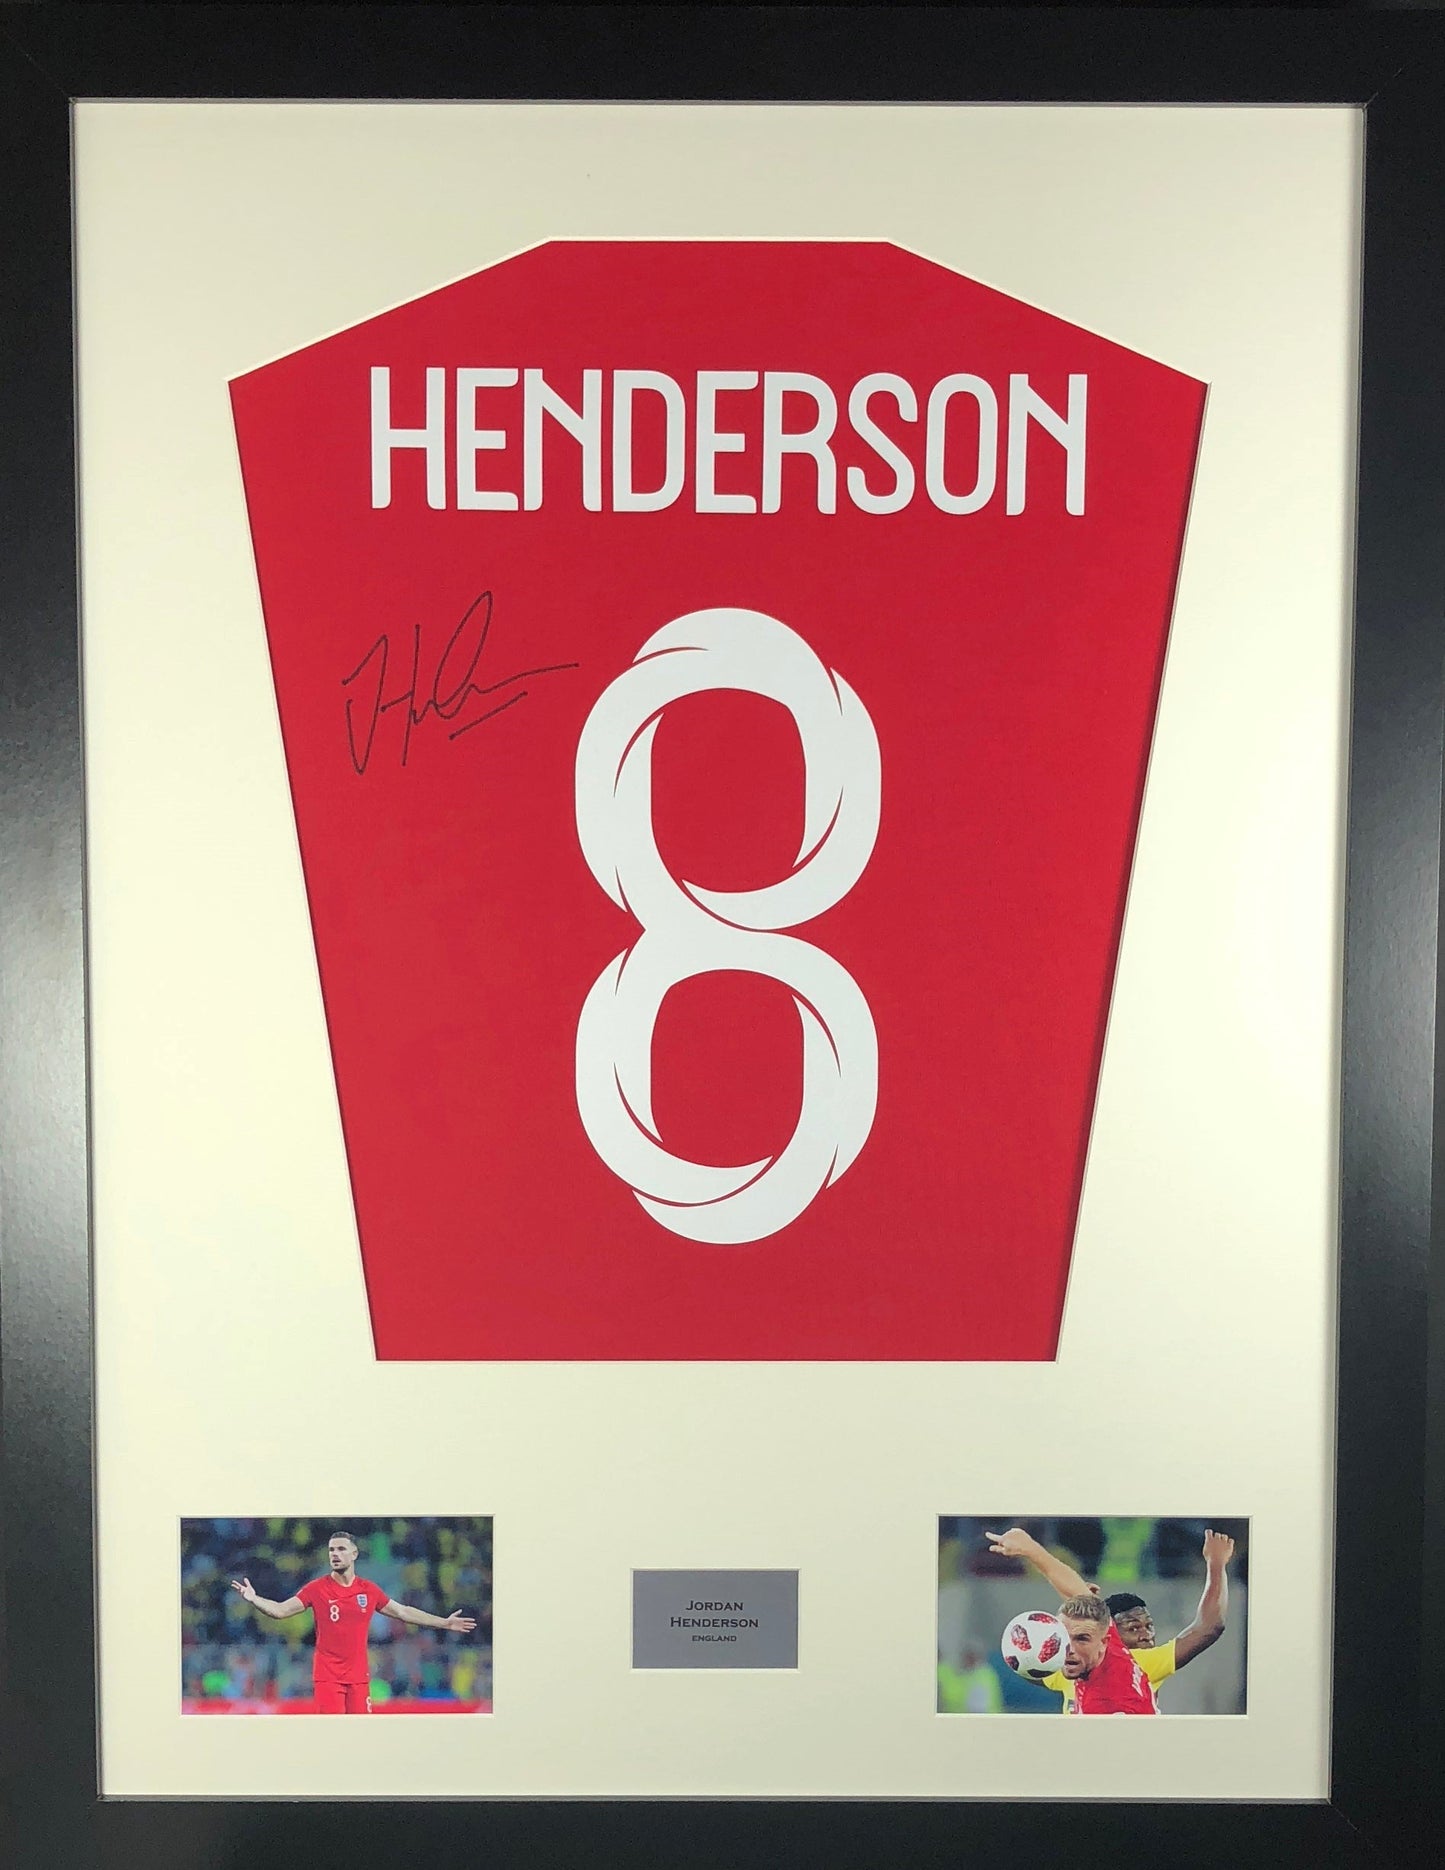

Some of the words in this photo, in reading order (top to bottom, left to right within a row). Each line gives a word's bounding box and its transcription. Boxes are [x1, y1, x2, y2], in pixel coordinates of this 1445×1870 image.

[371, 367, 1088, 516] HENDERSON
[575, 608, 882, 1245] 8
[330, 1604, 340, 1622] 8
[685, 1600, 744, 1611] JORDAN
[670, 1616, 759, 1628] HENDERSON
